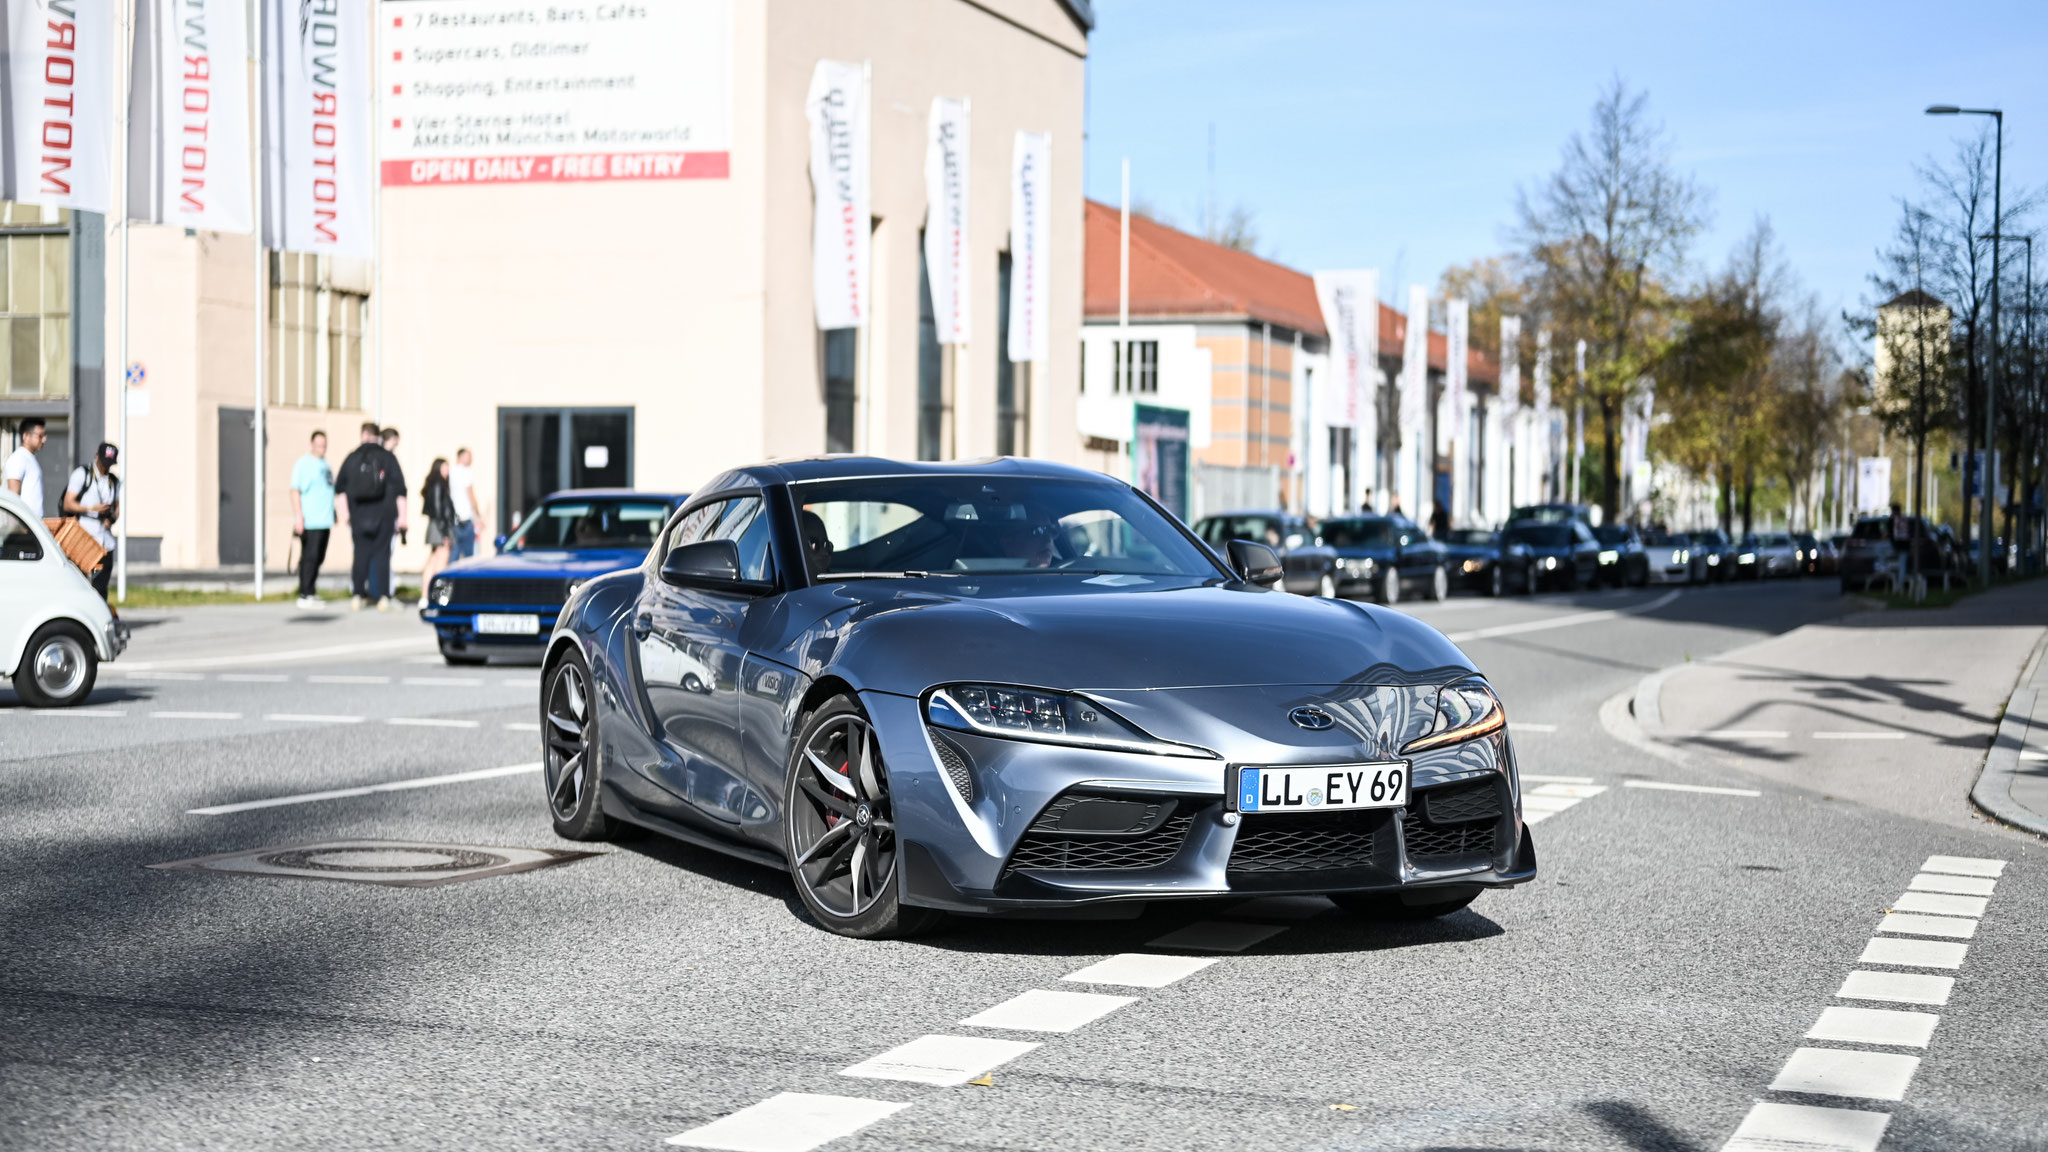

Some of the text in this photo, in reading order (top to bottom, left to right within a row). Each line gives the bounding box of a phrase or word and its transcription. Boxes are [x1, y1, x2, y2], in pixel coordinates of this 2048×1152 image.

[414, 12, 423, 28] 7
[429, 9, 541, 27] Restaurants,
[547, 6, 591, 23] Bars,
[413, 41, 590, 64] Supercars, Oldtimer
[413, 75, 635, 98] Shopping, Entertainment
[411, 160, 470, 182] OPEN
[474, 157, 535, 181] DAILY
[551, 155, 607, 178] FREE
[611, 153, 685, 178] ENTRY
[1246, 769, 1403, 806] D LL EY 69
